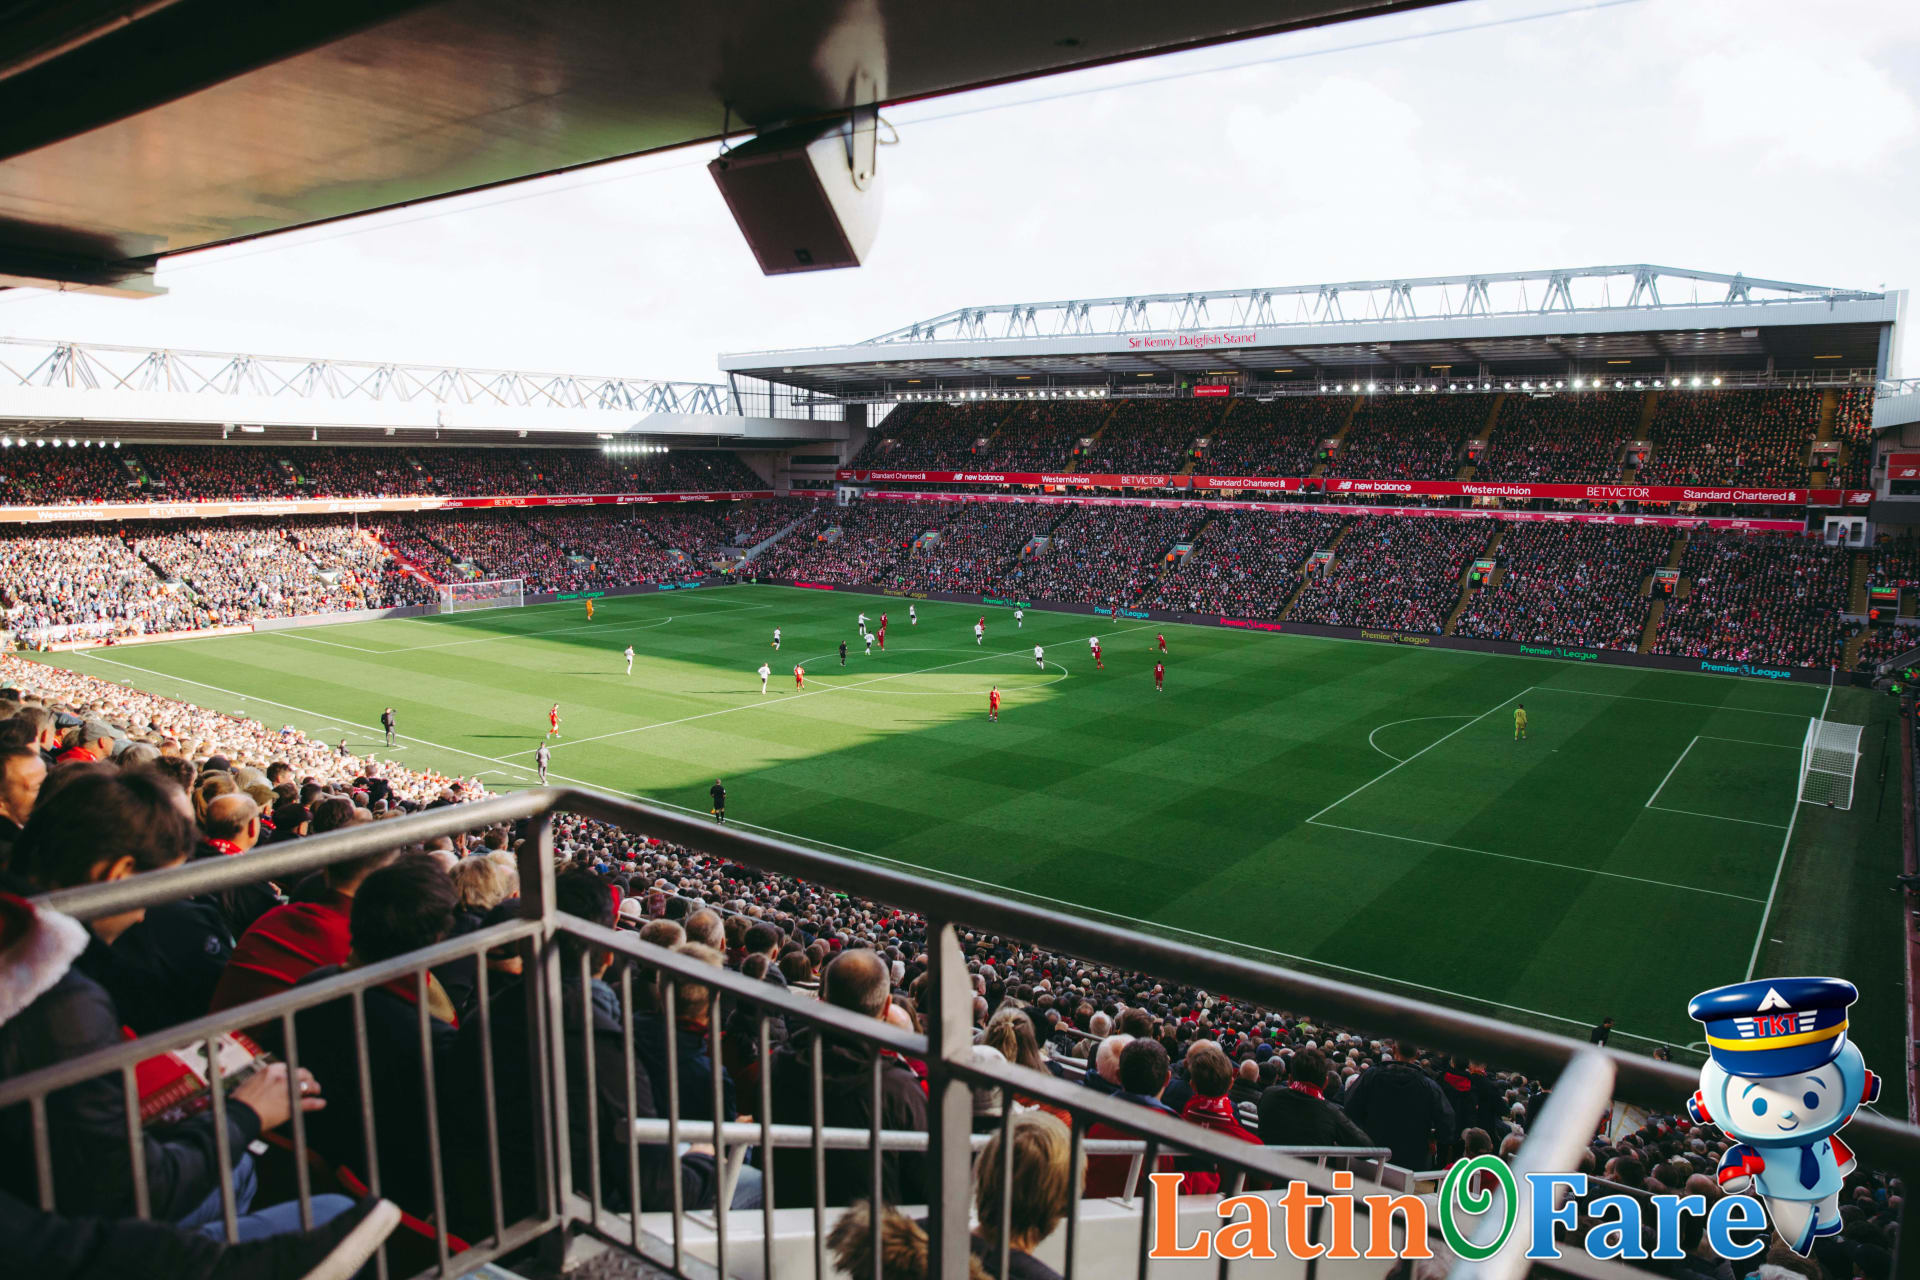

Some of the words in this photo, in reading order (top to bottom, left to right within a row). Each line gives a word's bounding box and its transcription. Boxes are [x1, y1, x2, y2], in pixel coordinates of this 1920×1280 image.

[1128, 337, 1141, 348] Sir
[1144, 336, 1176, 349] Kenny
[1180, 334, 1221, 349] Dalglish
[1223, 332, 1257, 344] Stand
[871, 472, 894, 480] Standard
[895, 472, 922, 480] Chartered
[978, 474, 1005, 482] balance
[1041, 476, 1090, 484] WesternUnion
[1121, 476, 1164, 485] BETVICTOR
[1209, 478, 1242, 487] Standard
[1243, 479, 1279, 488] Chartered
[1354, 482, 1373, 490] new
[1374, 482, 1412, 492] balance
[1462, 484, 1531, 495] WesternUnion
[1586, 486, 1650, 498] BETVICTOR
[1683, 490, 1731, 500] Standard
[1733, 490, 1787, 501] Chartered
[494, 498, 526, 506] BETVICTOR
[38, 510, 104, 520] WesternUnion
[557, 592, 578, 600] Premier
[583, 590, 605, 599] League
[883, 588, 904, 597] Premier
[910, 591, 928, 600] eague
[983, 597, 1004, 606] Premier
[1125, 609, 1149, 618] League
[1220, 617, 1245, 628] Premier
[1254, 621, 1282, 631] League
[1361, 630, 1390, 640] Premier
[1399, 634, 1430, 644] League
[1520, 644, 1553, 656] Premier
[1563, 647, 1598, 661] League
[1701, 662, 1739, 674] Premier
[1751, 666, 1791, 680] League
